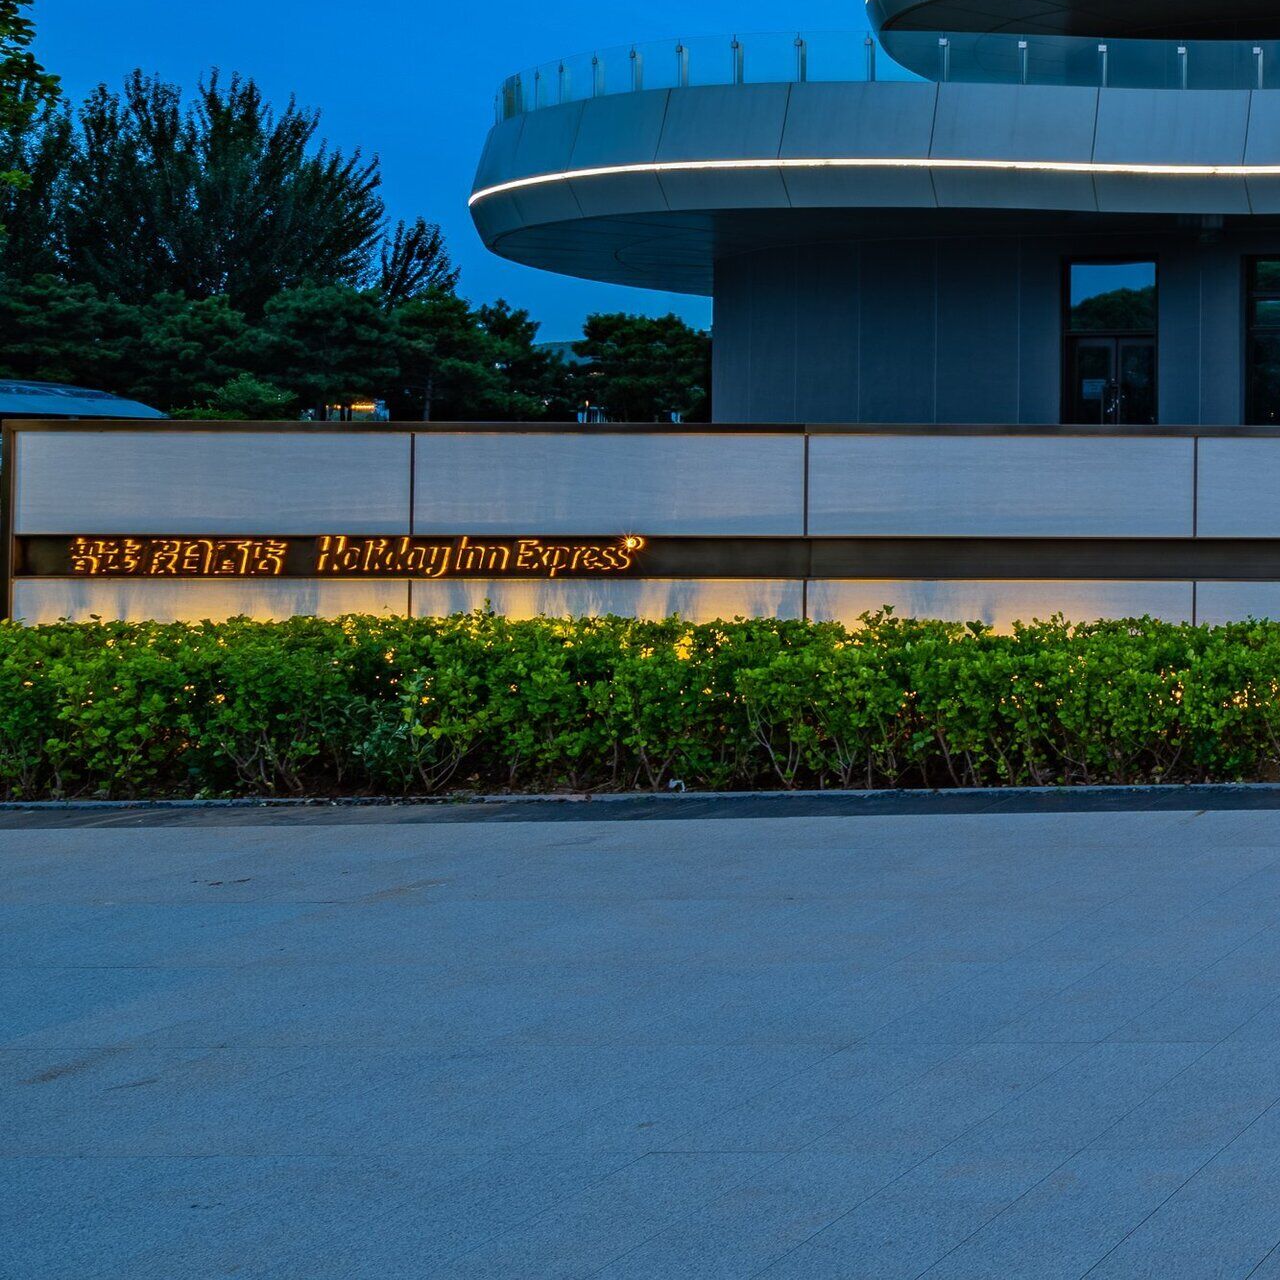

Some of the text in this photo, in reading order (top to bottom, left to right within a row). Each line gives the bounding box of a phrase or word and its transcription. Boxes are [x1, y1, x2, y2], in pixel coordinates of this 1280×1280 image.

[317, 535, 632, 578] Holiday Inn Express
